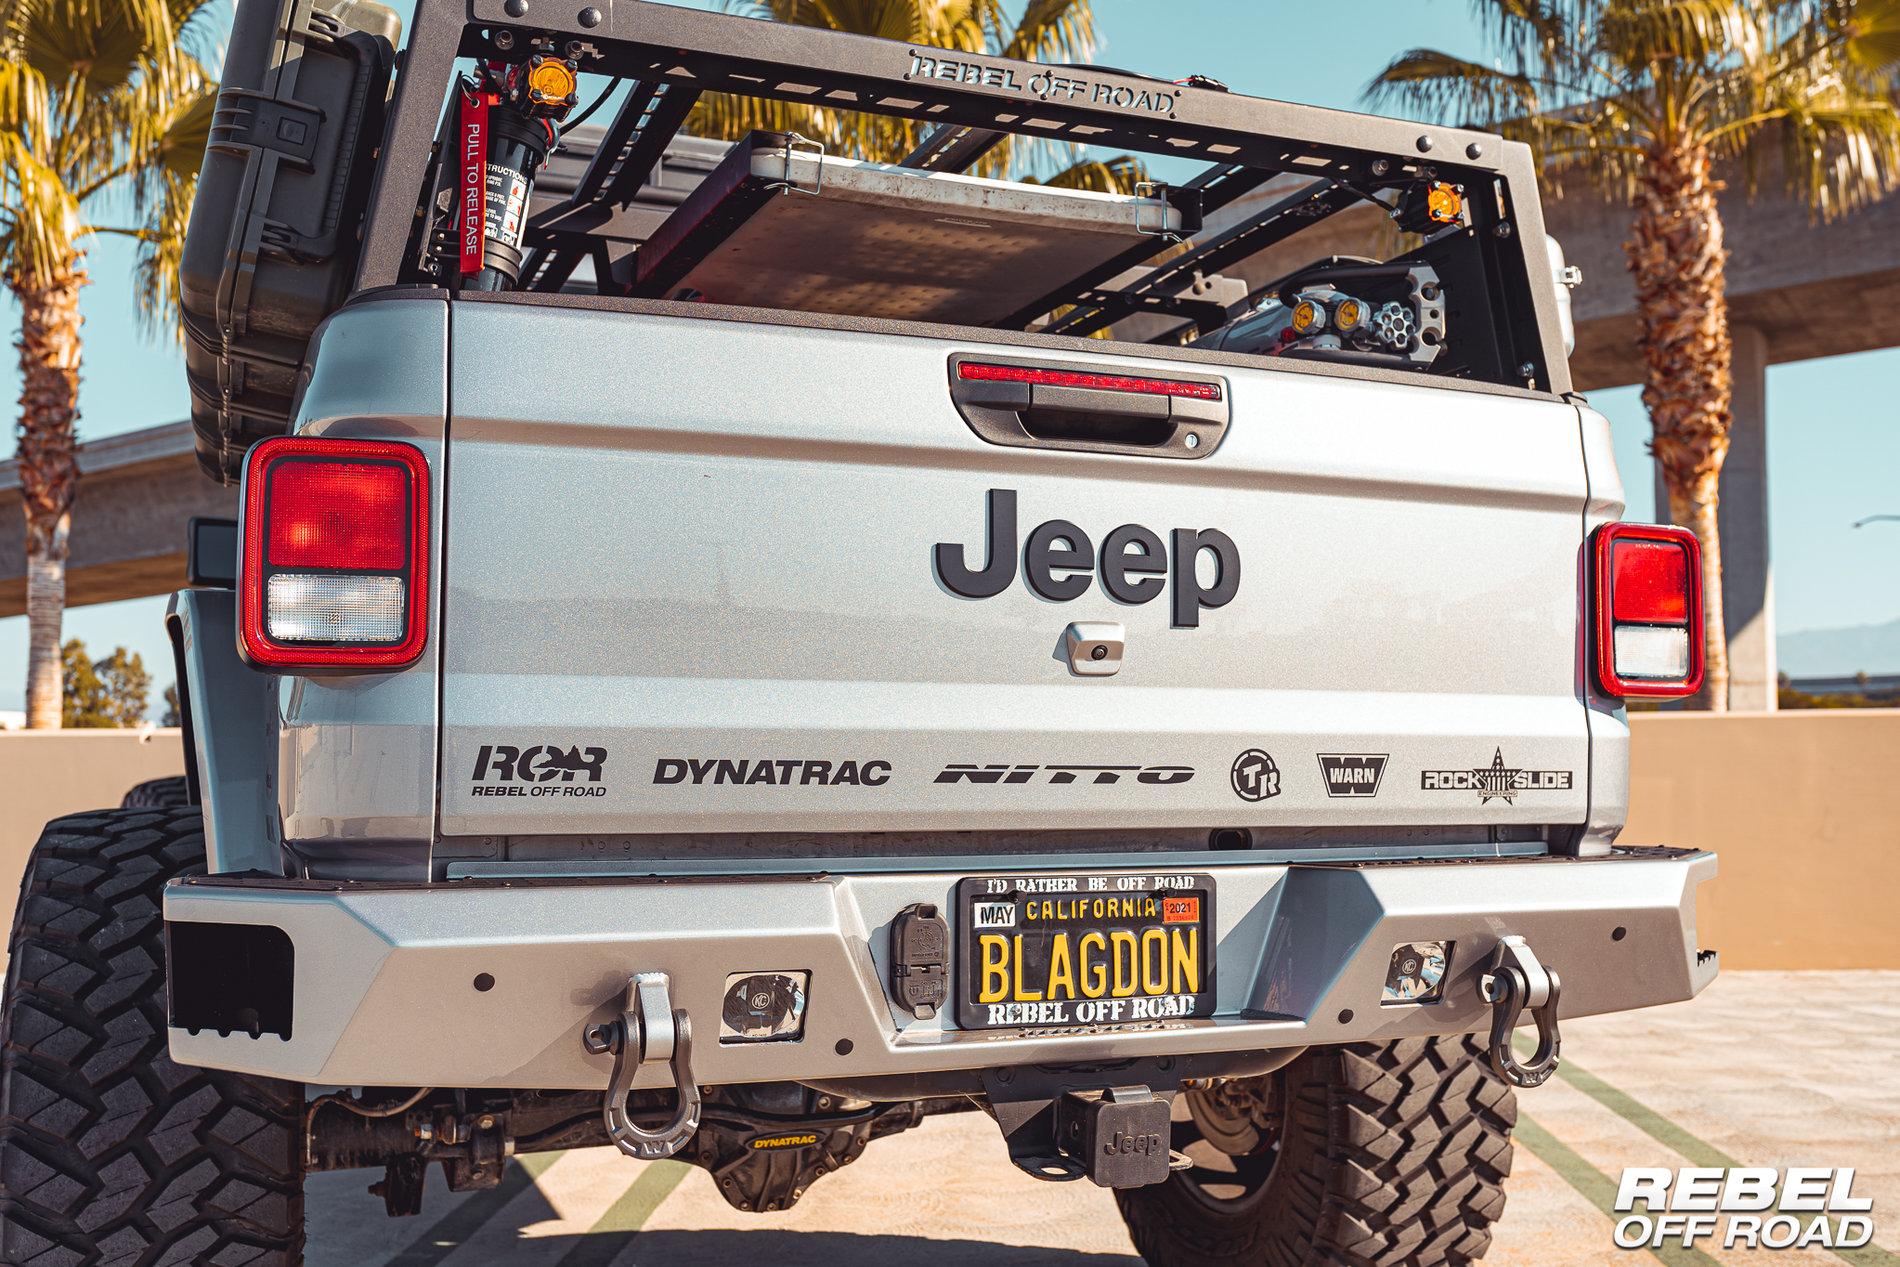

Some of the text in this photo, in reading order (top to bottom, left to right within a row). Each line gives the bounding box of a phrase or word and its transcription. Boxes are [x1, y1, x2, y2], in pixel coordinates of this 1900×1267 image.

[910, 56, 1175, 113] REBEL OFF ROAD
[466, 123, 480, 255] PULL TO RELEASE
[933, 488, 1241, 628] Jeep
[653, 759, 893, 787] DYNATRAC
[933, 764, 1196, 785] NITTO
[1330, 767, 1375, 784] WARN
[1424, 771, 1570, 789] ROCK SLIDE
[471, 786, 607, 797] REBEL OFF ROAD
[1015, 878, 1078, 893] RATHER
[1088, 877, 1108, 891] BE
[1116, 876, 1146, 891] OFF
[1154, 875, 1195, 890] ROAD
[980, 906, 1014, 925] MAY
[1025, 897, 1156, 921] CALIFORNIA
[1169, 902, 1191, 914] 2021
[979, 928, 1199, 1004] BLAGDON
[987, 995, 1196, 1026] REBEL OFF ROAD
[753, 1134, 817, 1149] DYNATRAC
[1103, 1131, 1162, 1156] Jeep
